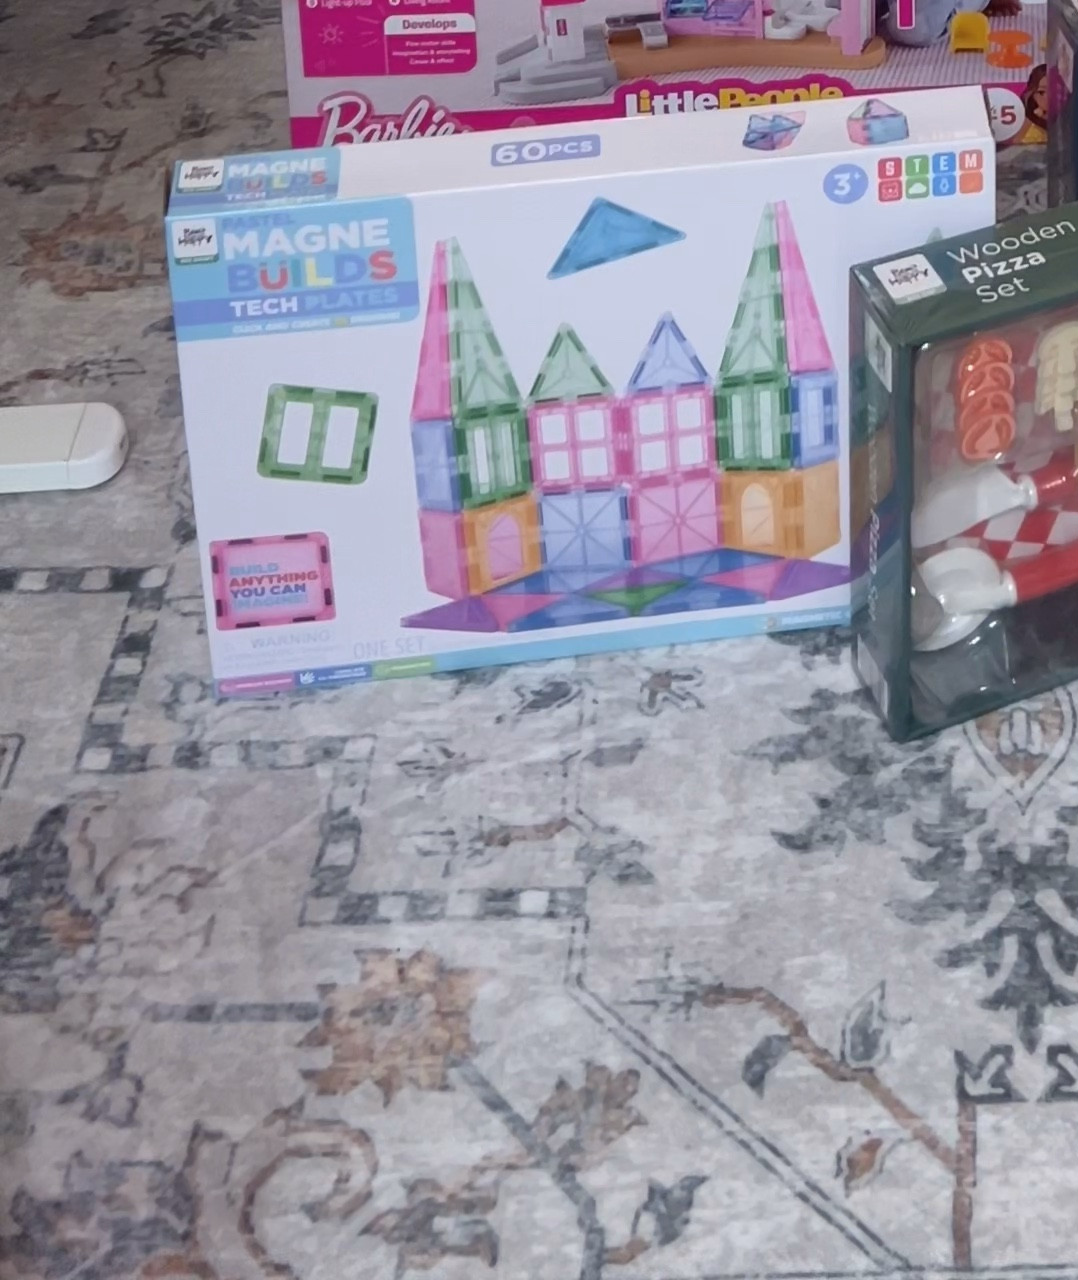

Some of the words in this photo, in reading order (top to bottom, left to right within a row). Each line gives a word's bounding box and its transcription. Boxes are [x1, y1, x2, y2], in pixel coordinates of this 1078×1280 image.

[403, 18, 457, 31] Develops
[228, 157, 327, 179] MAGNE
[226, 191, 266, 202] TECH
[223, 217, 391, 261] MAGNE
[946, 220, 1076, 265] Wooden
[227, 249, 398, 293] BUILDS
[961, 251, 1047, 284] Pizza
[976, 277, 1031, 303] Set
[229, 296, 298, 318] TECH
[305, 288, 399, 311] PLATES
[229, 571, 319, 588] ANYTHING
[230, 587, 266, 599] YOU
[270, 583, 306, 595] CAN
[353, 641, 389, 660] ONE
[396, 636, 426, 655] SET
